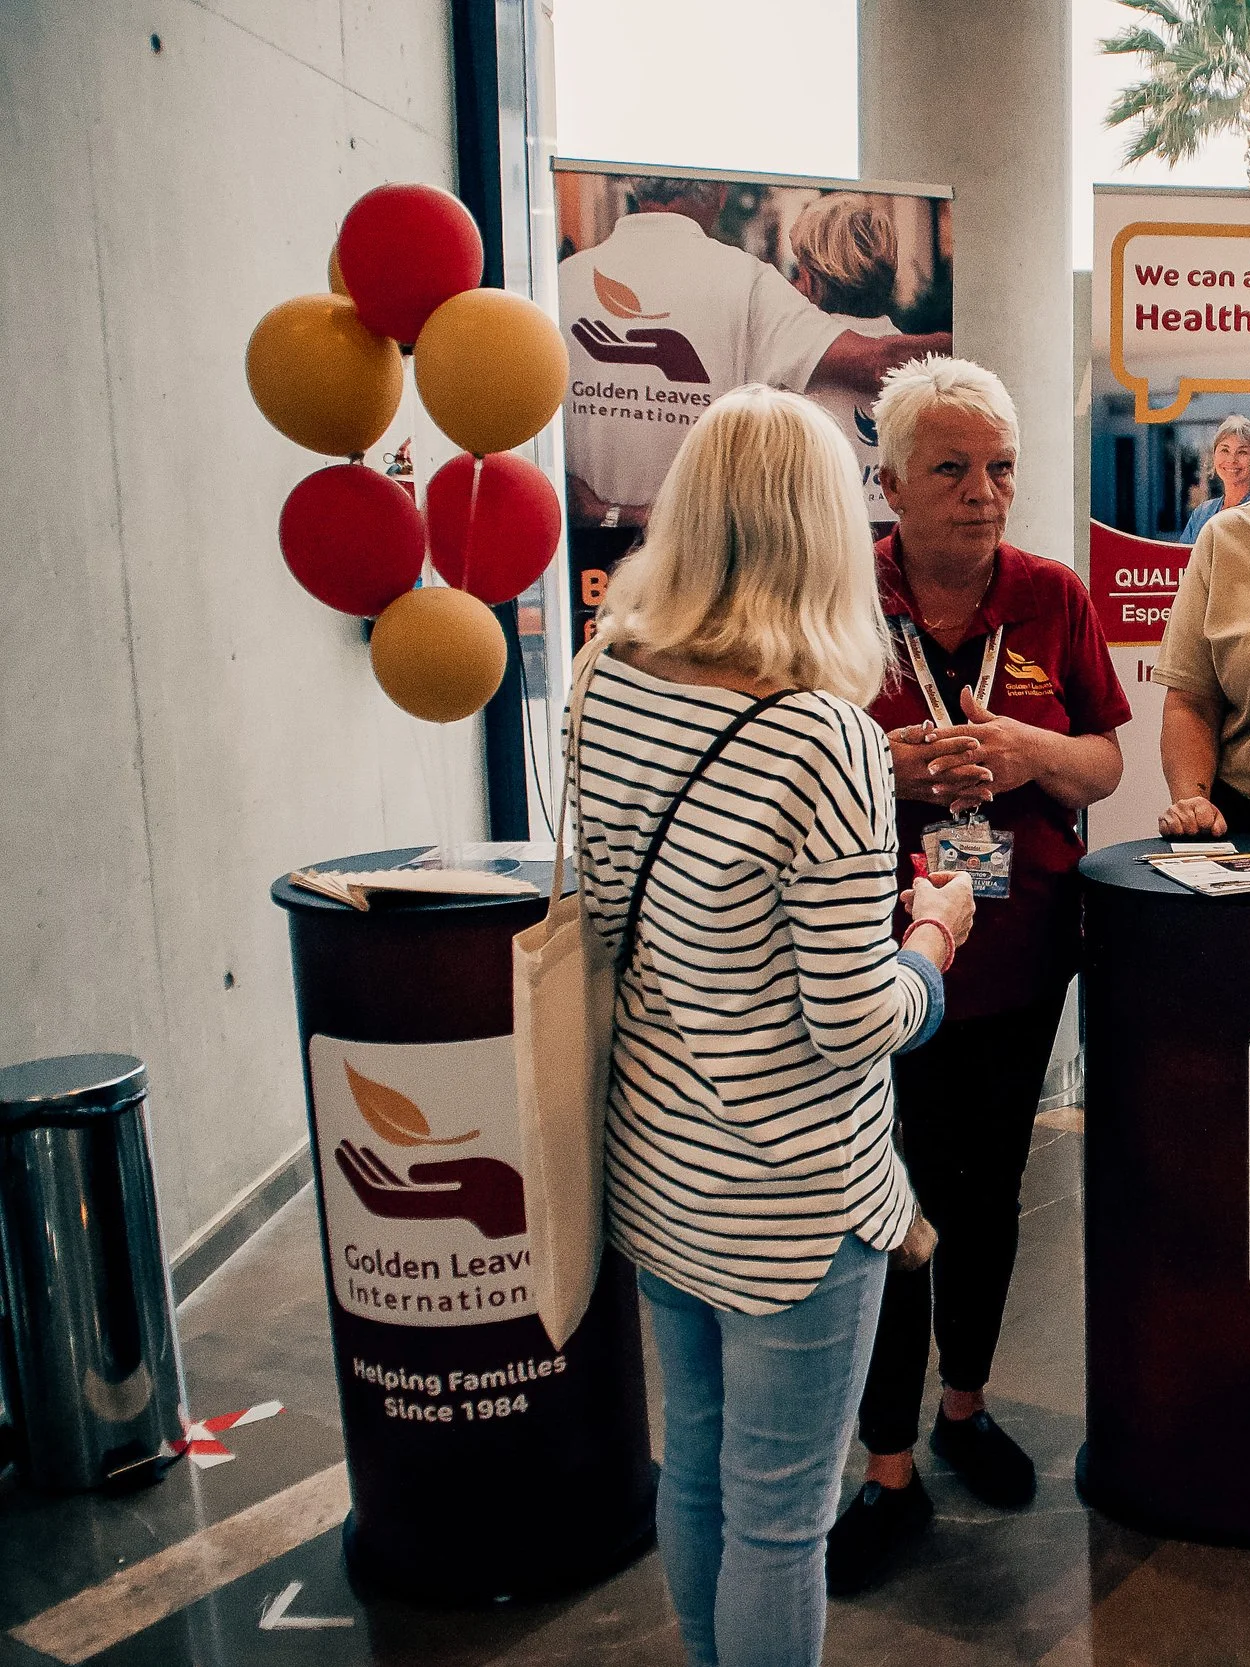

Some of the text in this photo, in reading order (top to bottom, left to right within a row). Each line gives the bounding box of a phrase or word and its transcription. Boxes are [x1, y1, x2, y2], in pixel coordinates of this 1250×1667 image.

[1135, 264, 1179, 286] We
[1187, 269, 1235, 287] can
[572, 381, 711, 407] Golden Leaves
[572, 401, 699, 425] Internation
[1115, 568, 1186, 587] QUALI
[1123, 604, 1172, 625] Espe
[345, 1244, 530, 1279] Golden Leav
[349, 1279, 529, 1313] Internation
[353, 1355, 567, 1396] Helping Families
[383, 1393, 529, 1422] Since 1984
